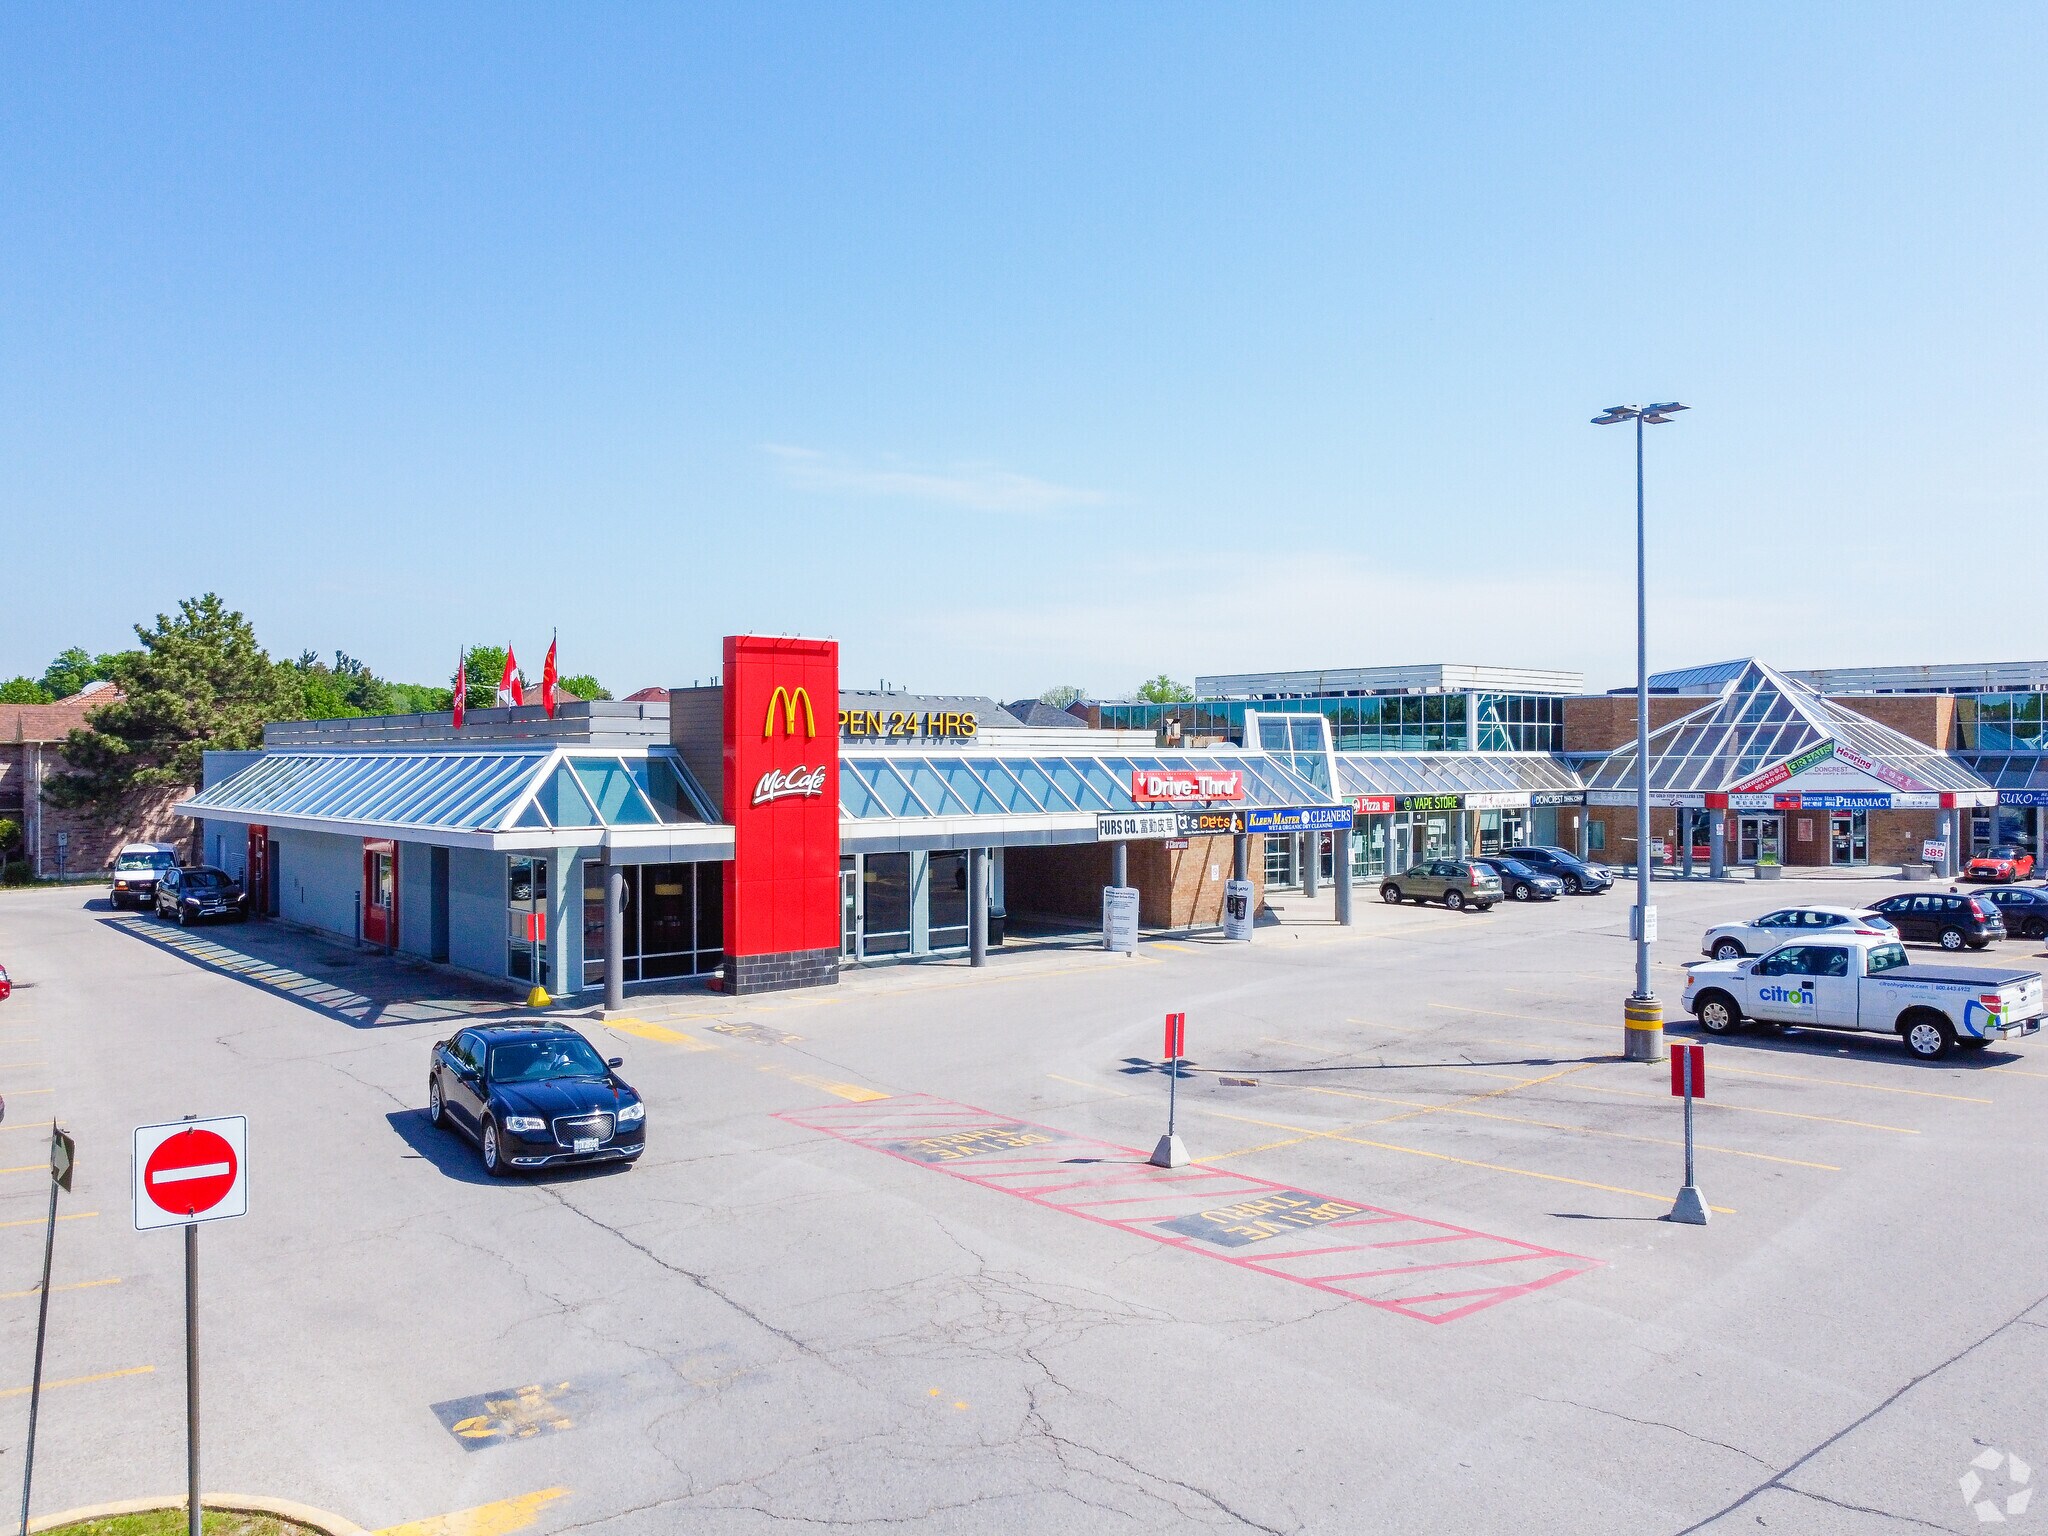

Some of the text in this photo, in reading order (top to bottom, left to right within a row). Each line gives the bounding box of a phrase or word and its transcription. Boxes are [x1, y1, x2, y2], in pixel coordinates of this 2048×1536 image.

[838, 710, 977, 737] PEN 24 HRS
[1836, 746, 1872, 769] Hearing
[753, 765, 826, 804] McCafé
[1148, 776, 1236, 796] Drive-Thru
[1739, 771, 1770, 791] TAEKWONDO
[1361, 798, 1381, 811] Pizza
[1413, 796, 1458, 810] VAPE STORE
[1535, 794, 1564, 805] DONCREST
[1835, 795, 1890, 807] PHARMACY
[1999, 793, 2033, 804] SUKO
[1178, 814, 1231, 830] Q's pets
[1310, 809, 1352, 823] CLEANERS
[1099, 819, 1139, 836] FURS CO.
[1924, 848, 1944, 858] $85
[1759, 985, 1814, 1004] citron
[921, 1129, 1018, 1148] THRU
[925, 1133, 1053, 1160] DRIVE
[1201, 1196, 1310, 1224] THRU
[1222, 1202, 1362, 1241] DRIVE
